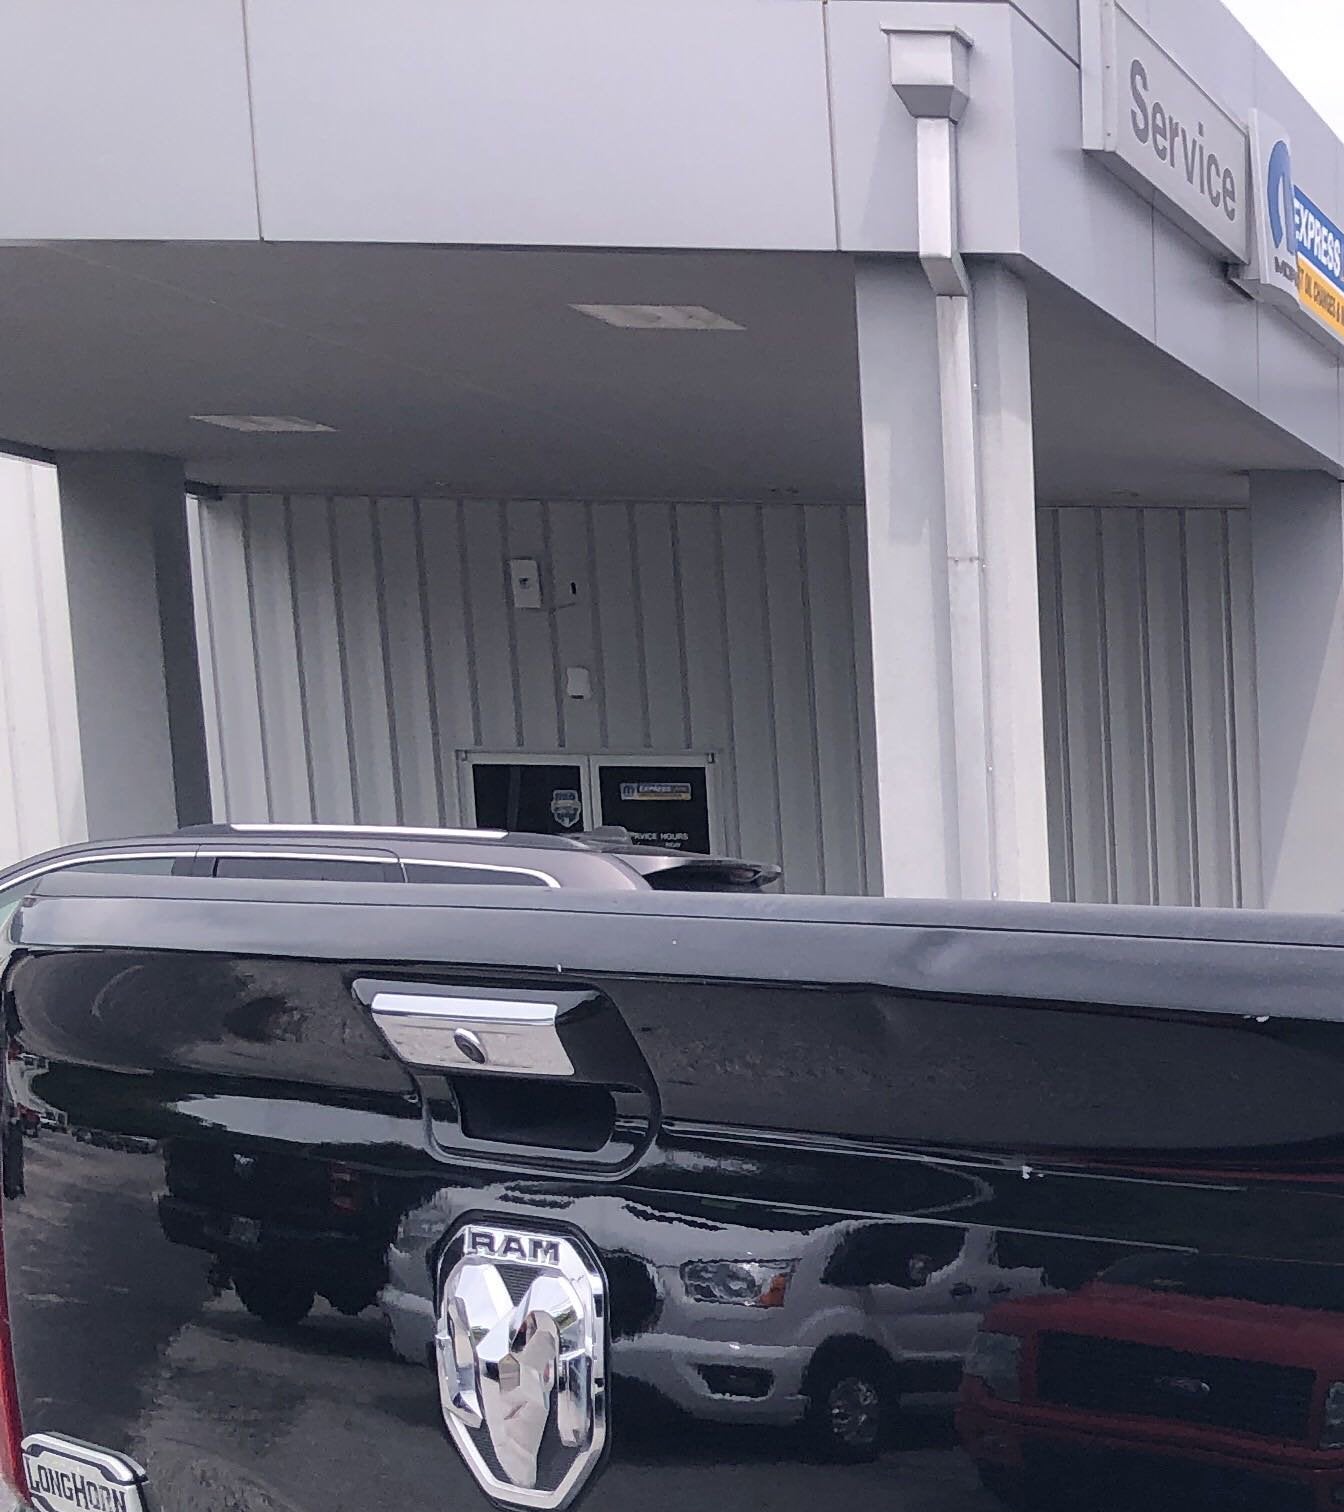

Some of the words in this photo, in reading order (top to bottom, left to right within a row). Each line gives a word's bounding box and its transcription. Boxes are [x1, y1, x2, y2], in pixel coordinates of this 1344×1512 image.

[1130, 58, 1236, 222] Service
[1294, 198, 1341, 278] EXPRESS
[661, 832, 688, 841] HOURS
[470, 1232, 560, 1266] RAM
